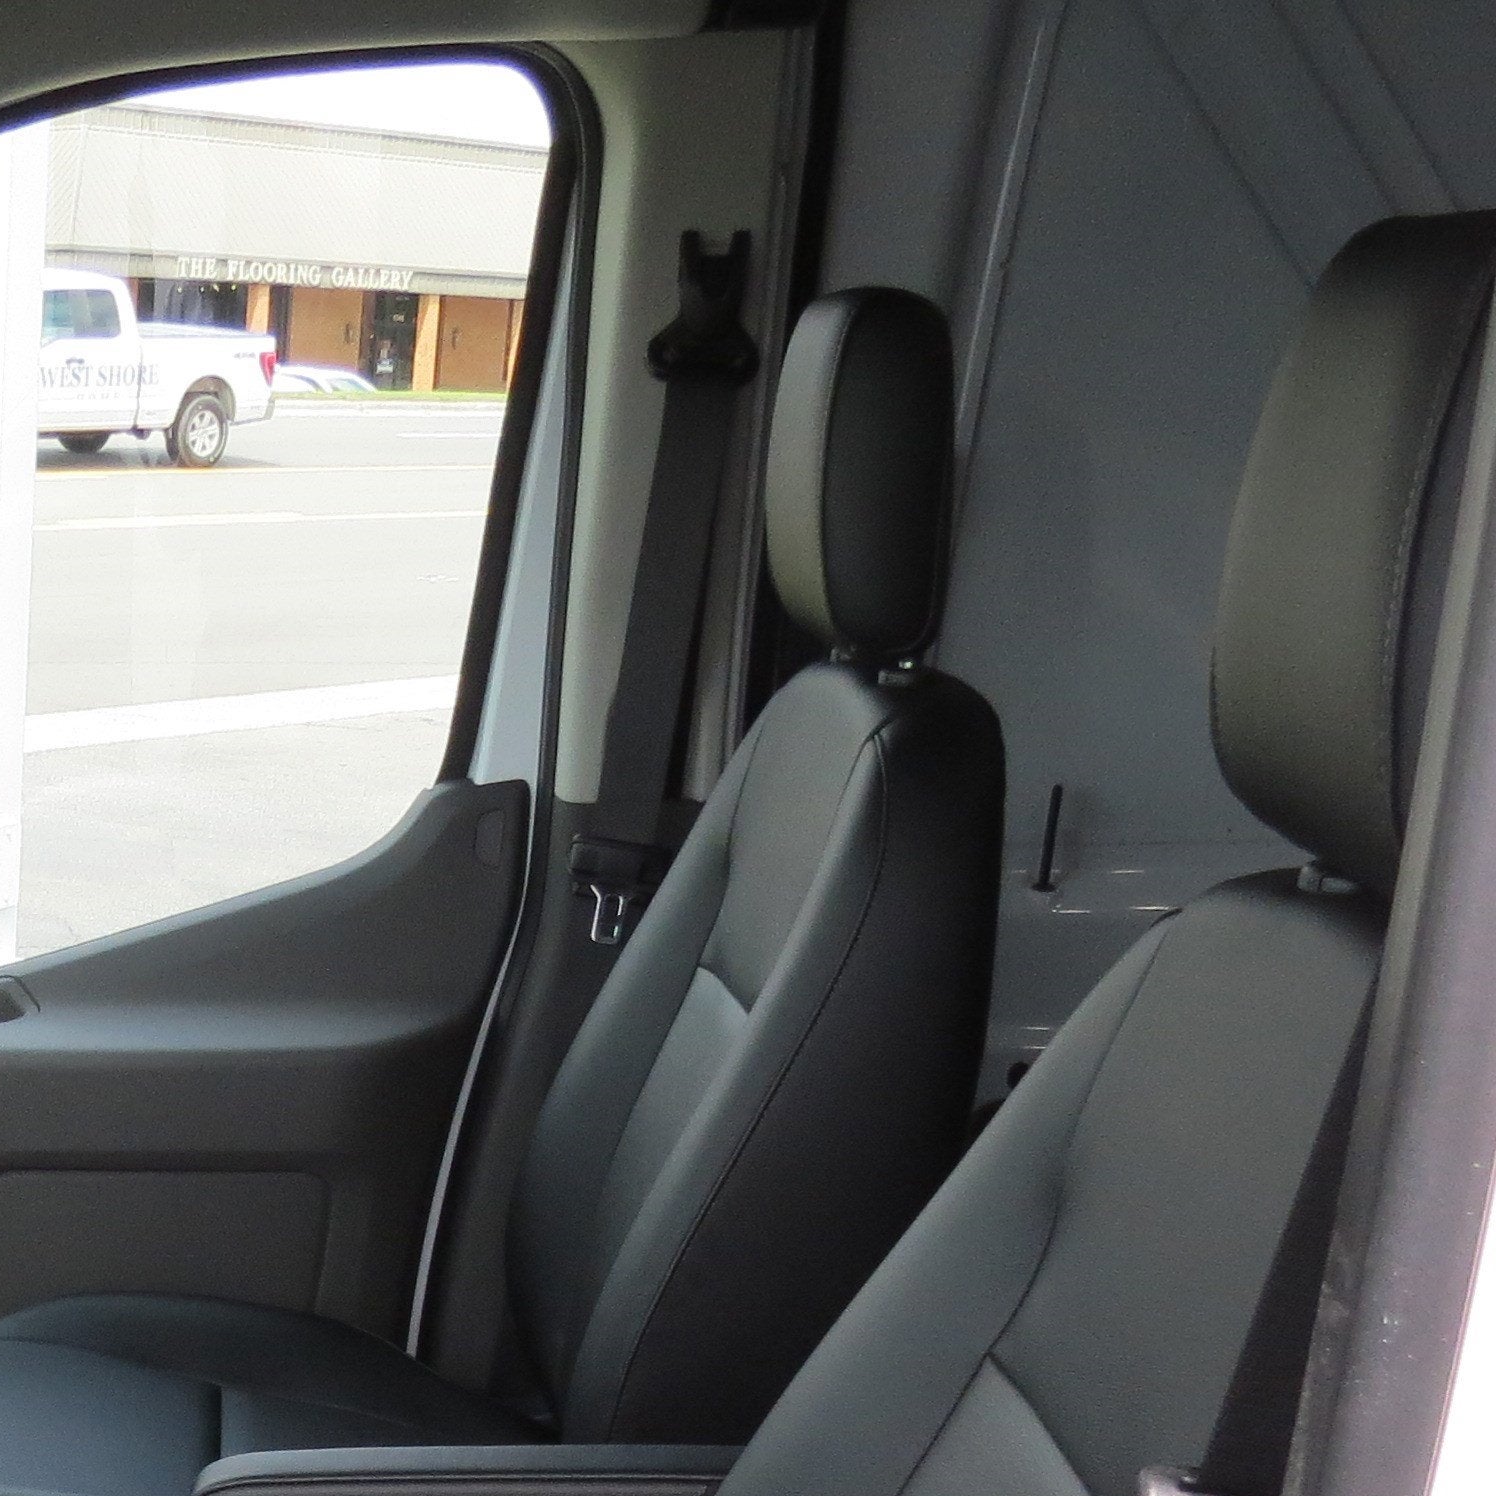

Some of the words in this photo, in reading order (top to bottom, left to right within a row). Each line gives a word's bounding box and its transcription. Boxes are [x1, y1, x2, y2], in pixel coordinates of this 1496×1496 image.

[176, 256, 217, 279] THE
[226, 259, 321, 285] FLOORING
[331, 267, 414, 291] GALLERY
[39, 364, 93, 388] WEST
[96, 363, 160, 387] SHORE
